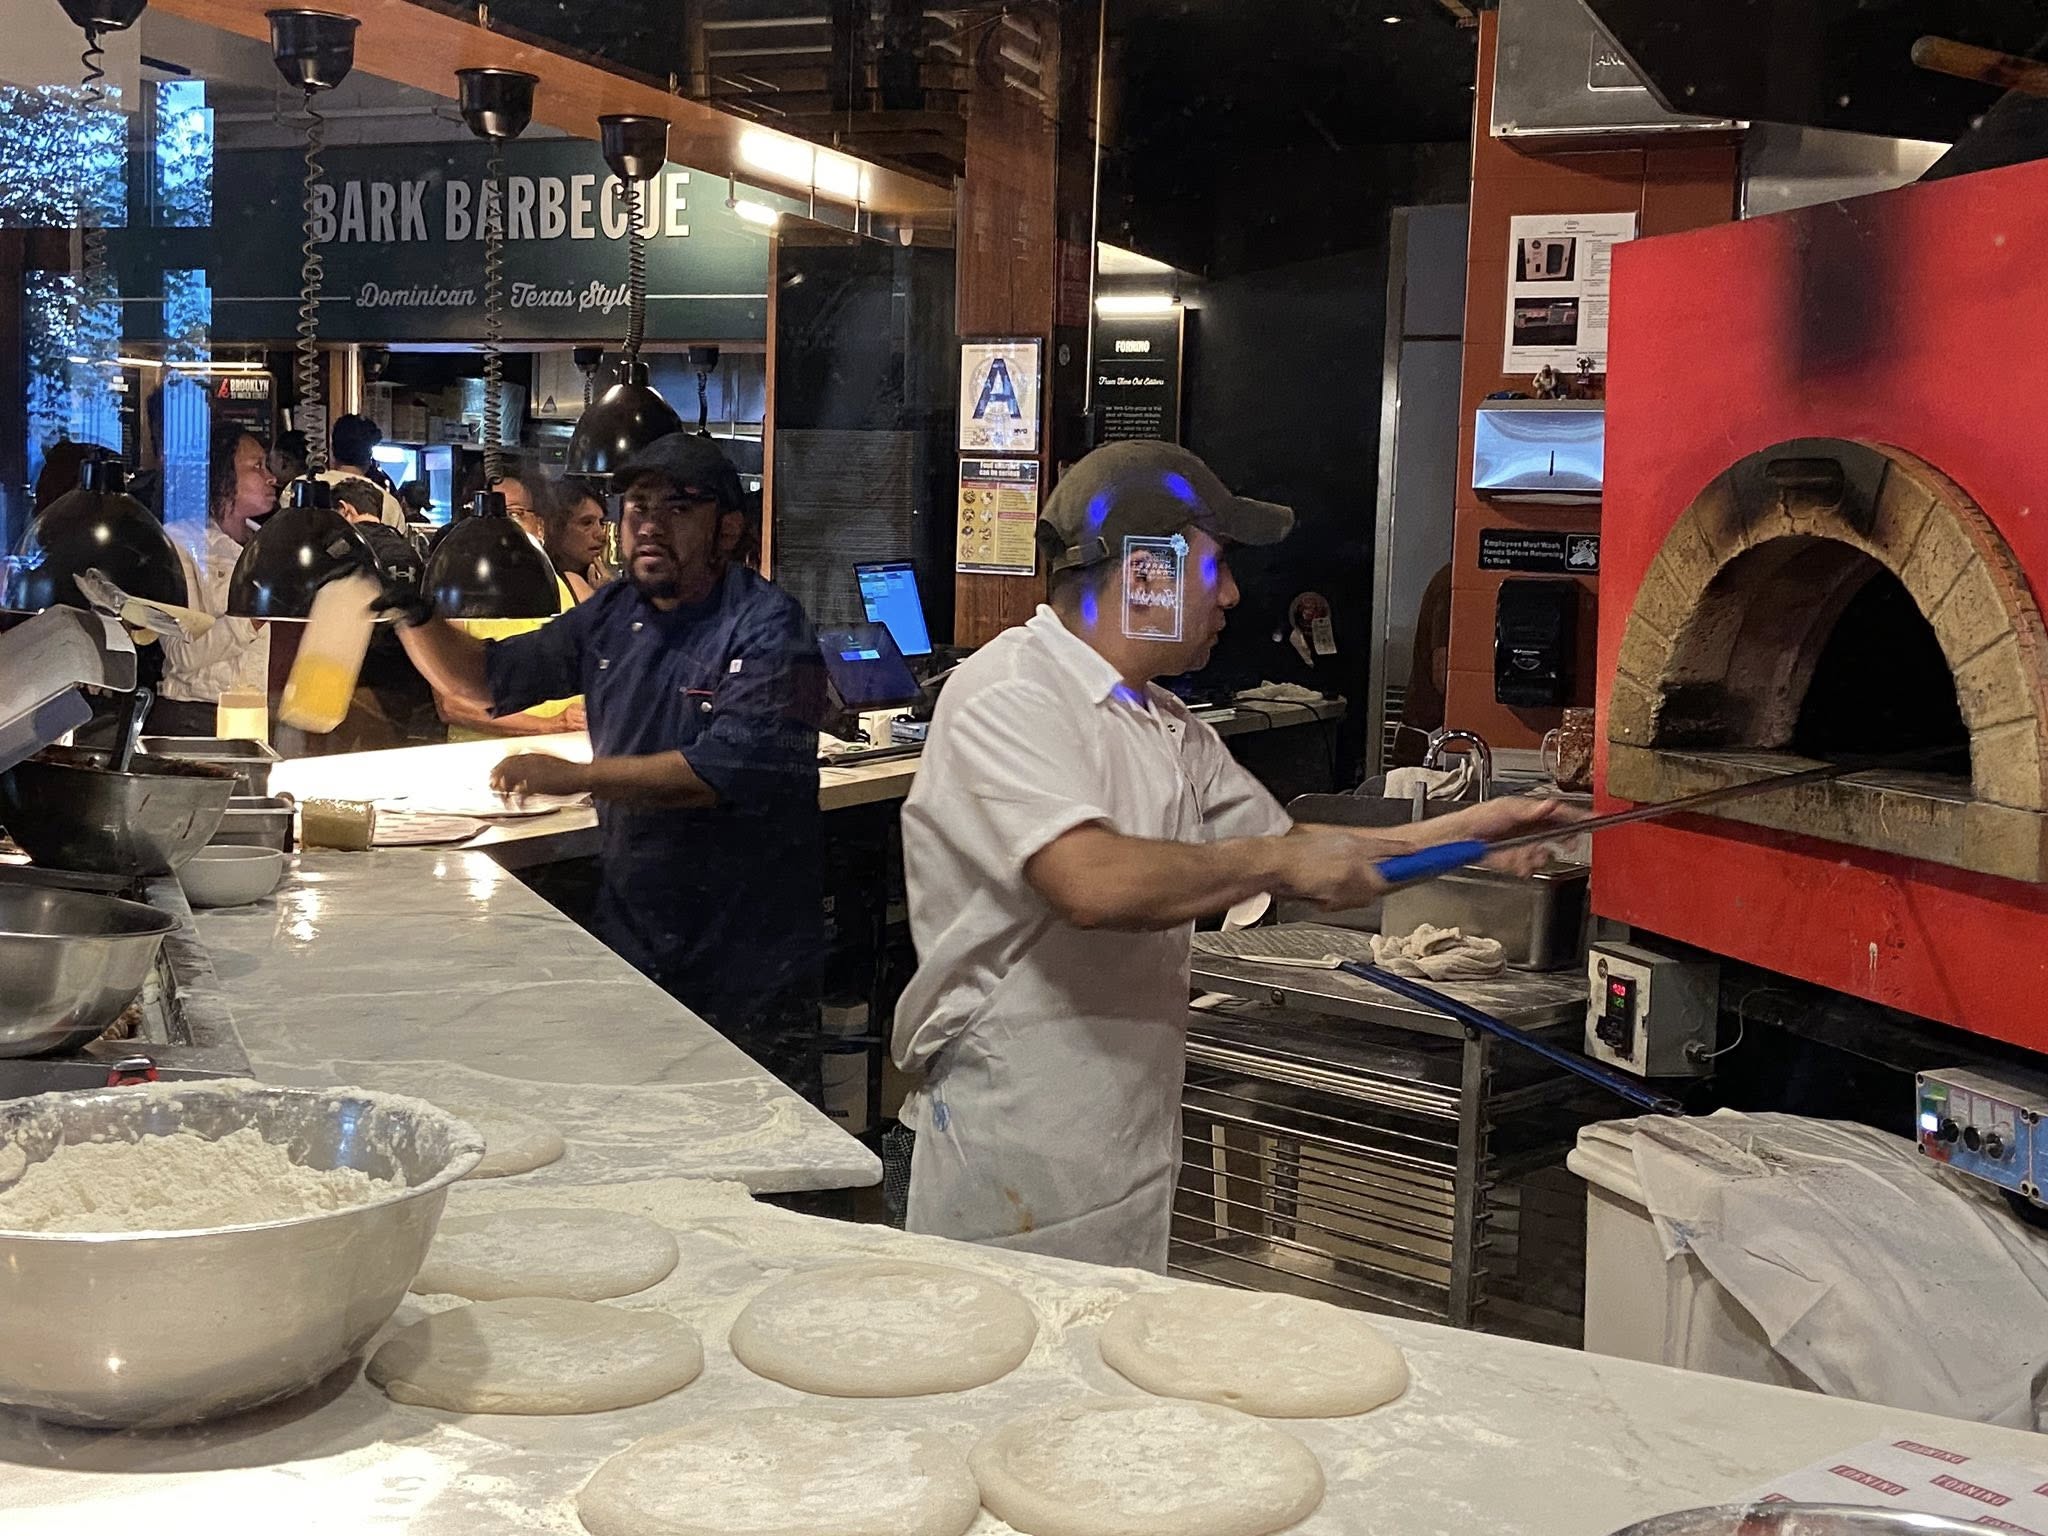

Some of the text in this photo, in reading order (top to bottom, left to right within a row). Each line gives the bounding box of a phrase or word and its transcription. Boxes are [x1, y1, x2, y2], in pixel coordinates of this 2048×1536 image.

[312, 172, 690, 243] BARK BARBECUE
[355, 282, 477, 308] Dominican
[510, 281, 576, 308] Texas
[229, 378, 270, 392] BROOKLYN
[972, 358, 1022, 419] A
[1482, 548, 1564, 559] Hands Before Returning
[1483, 539, 1561, 550] Employees Must Wash
[1483, 556, 1492, 564] To
[1832, 1466, 1904, 1495] FORNINO
[1934, 1475, 2007, 1505] FORNINO
